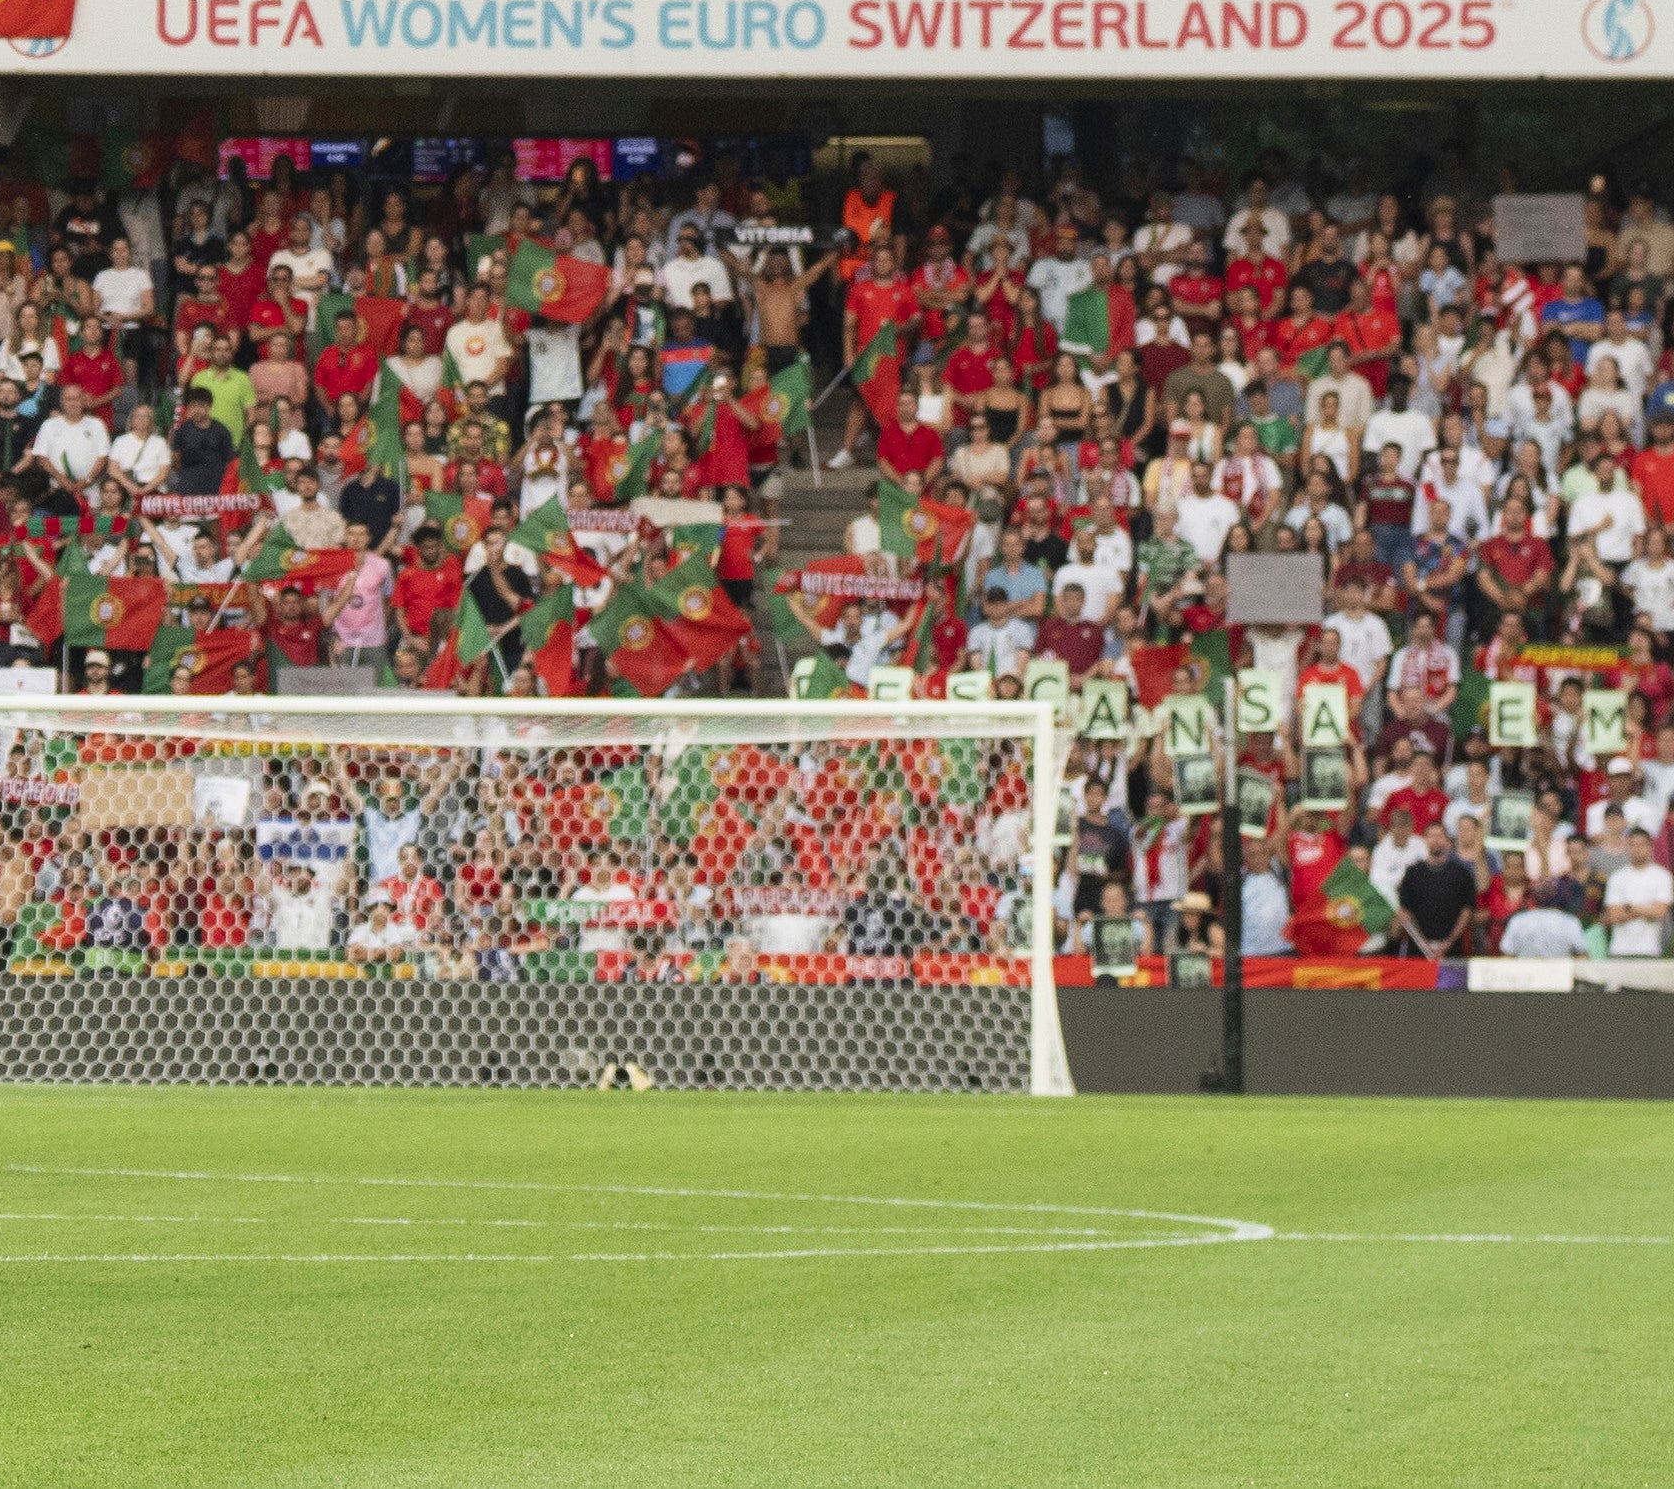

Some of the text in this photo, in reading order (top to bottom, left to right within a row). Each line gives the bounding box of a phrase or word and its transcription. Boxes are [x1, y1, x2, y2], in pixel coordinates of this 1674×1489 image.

[340, 0, 636, 49] WOMEN'S
[658, 0, 826, 49] EURO
[847, 0, 1310, 50] SWITZERLAND
[1331, 0, 1497, 50] 2025
